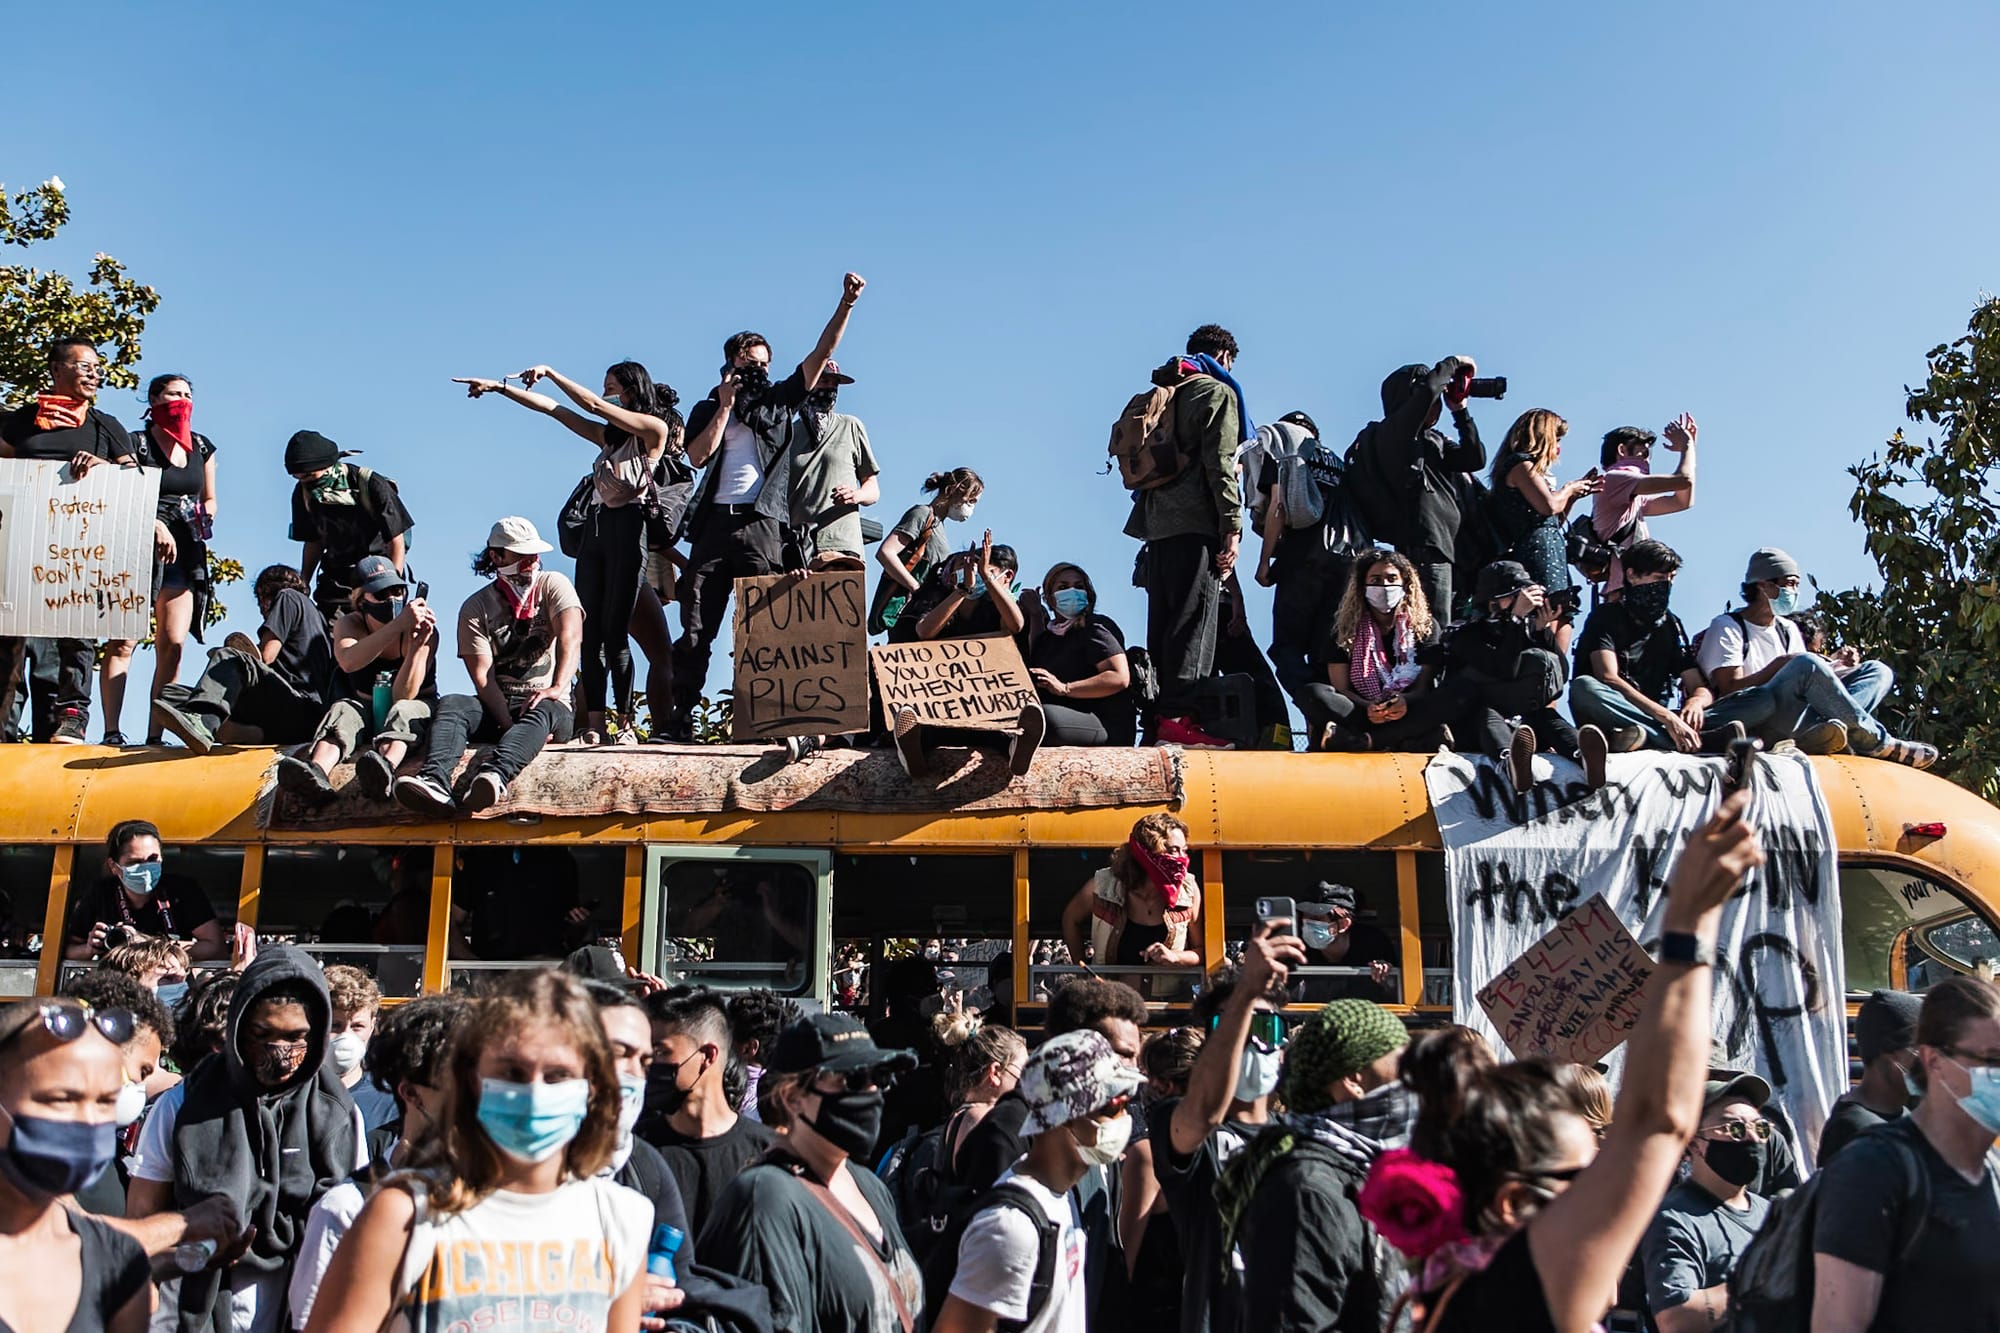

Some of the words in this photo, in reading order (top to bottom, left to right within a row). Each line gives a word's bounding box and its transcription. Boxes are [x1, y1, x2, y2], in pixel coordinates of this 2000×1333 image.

[49, 544, 106, 560] Serve
[107, 590, 146, 615] Help
[743, 578, 861, 634] PUNKS
[740, 641, 855, 674] AGAINST
[878, 643, 934, 665] WHO
[941, 639, 987, 660] DO
[885, 664, 930, 686] YOU
[936, 658, 996, 680] CALL
[885, 679, 965, 701] WHEN
[966, 671, 1021, 695] THE
[750, 676, 846, 721] PIGS
[1579, 954, 1637, 1010] NAME
